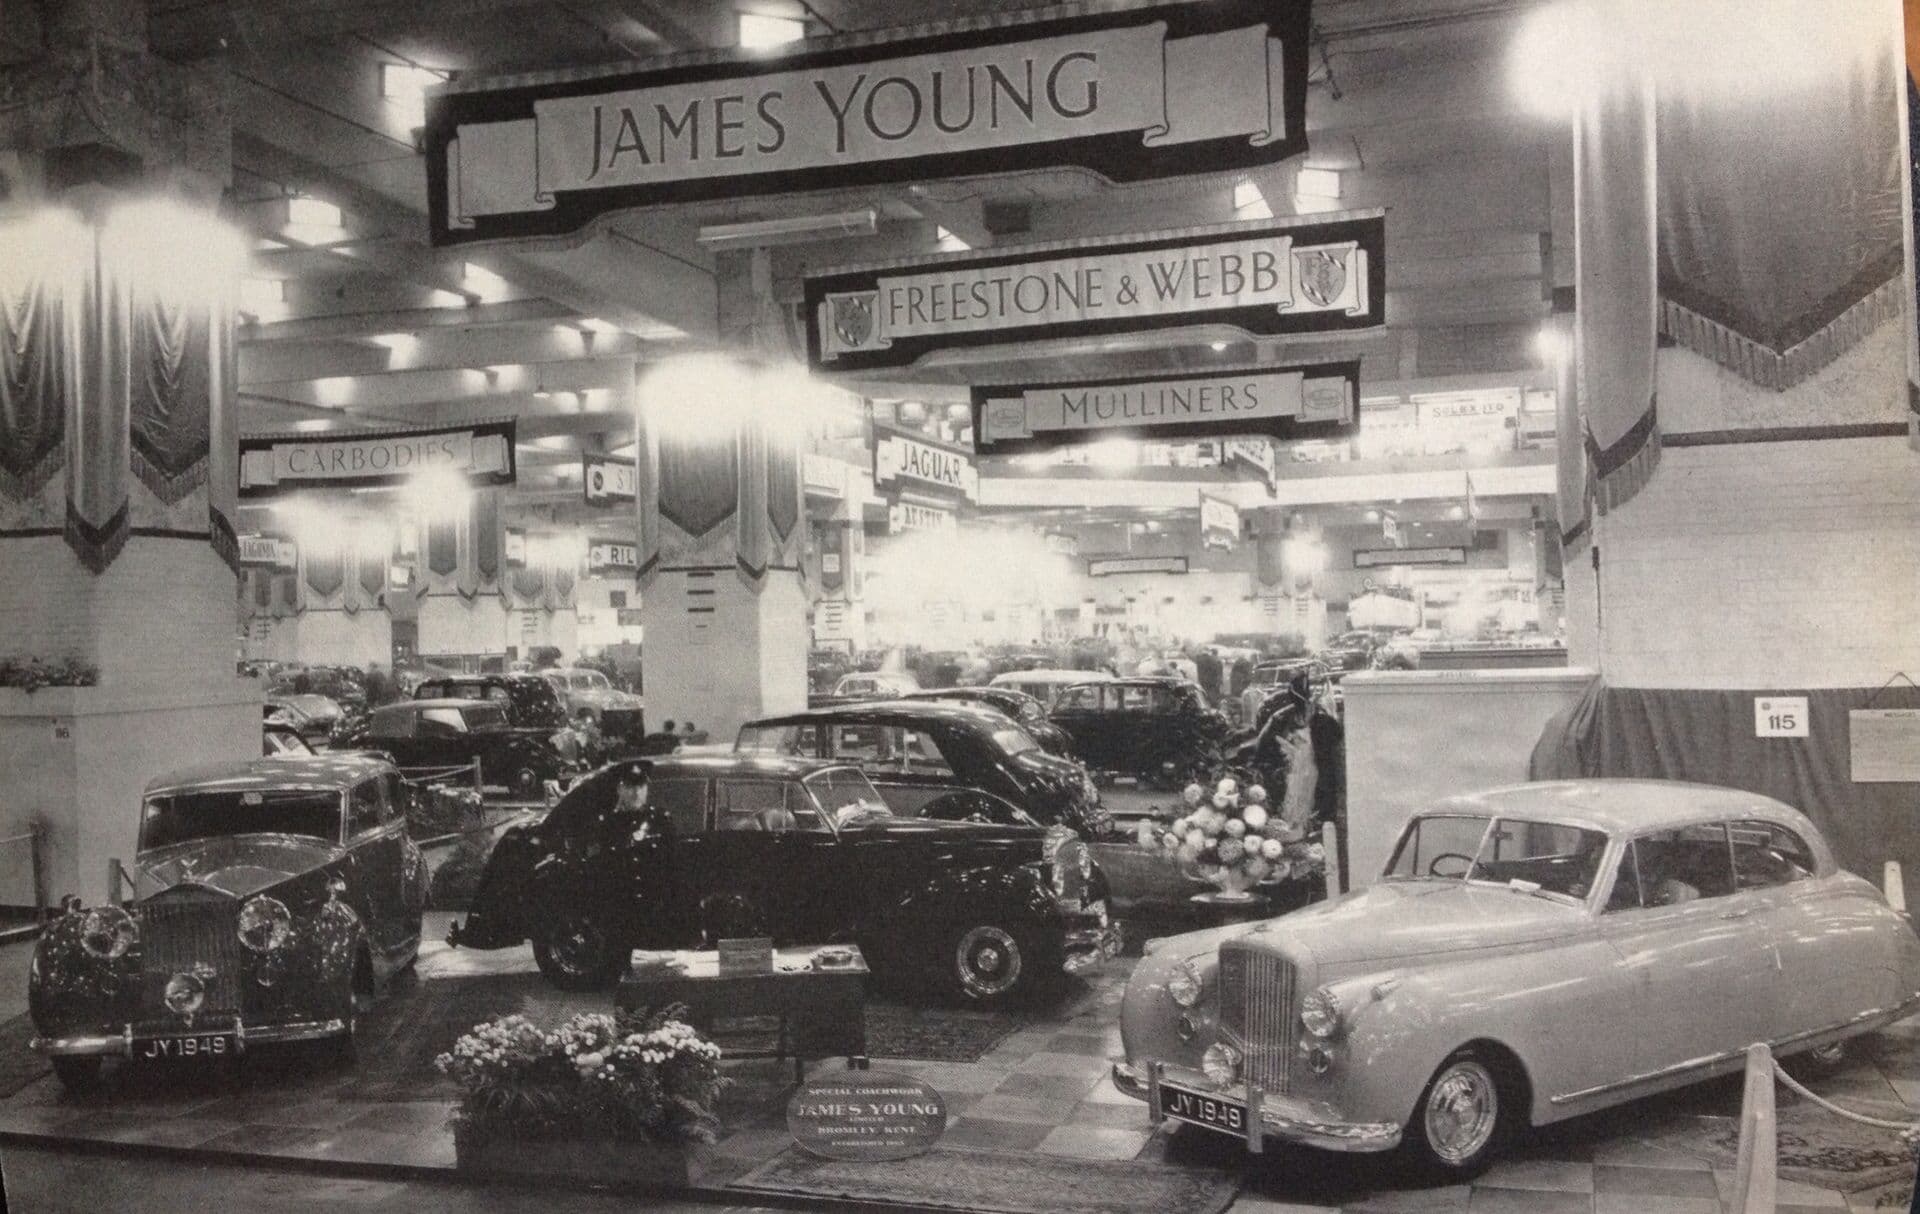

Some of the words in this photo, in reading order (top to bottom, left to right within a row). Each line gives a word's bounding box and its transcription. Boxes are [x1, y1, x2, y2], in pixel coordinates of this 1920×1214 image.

[586, 90, 786, 181] JAMES
[814, 51, 1099, 154] YOUNG
[888, 267, 1103, 326] FREESTONE
[1115, 276, 1140, 306] &
[1145, 250, 1280, 301] WEBB
[1061, 382, 1259, 426] MULLINERS
[288, 439, 455, 474] CARBODIES
[900, 442, 961, 486] JAGUAR
[1768, 713, 1797, 731] 115
[144, 1039, 170, 1057] JY
[177, 1036, 225, 1056] 1949
[798, 1103, 862, 1117] JAMES
[869, 1102, 939, 1116] YOUNG
[1170, 1093, 1193, 1115] JY
[1197, 1098, 1242, 1129] 1949
[884, 1126, 916, 1134] KENT
